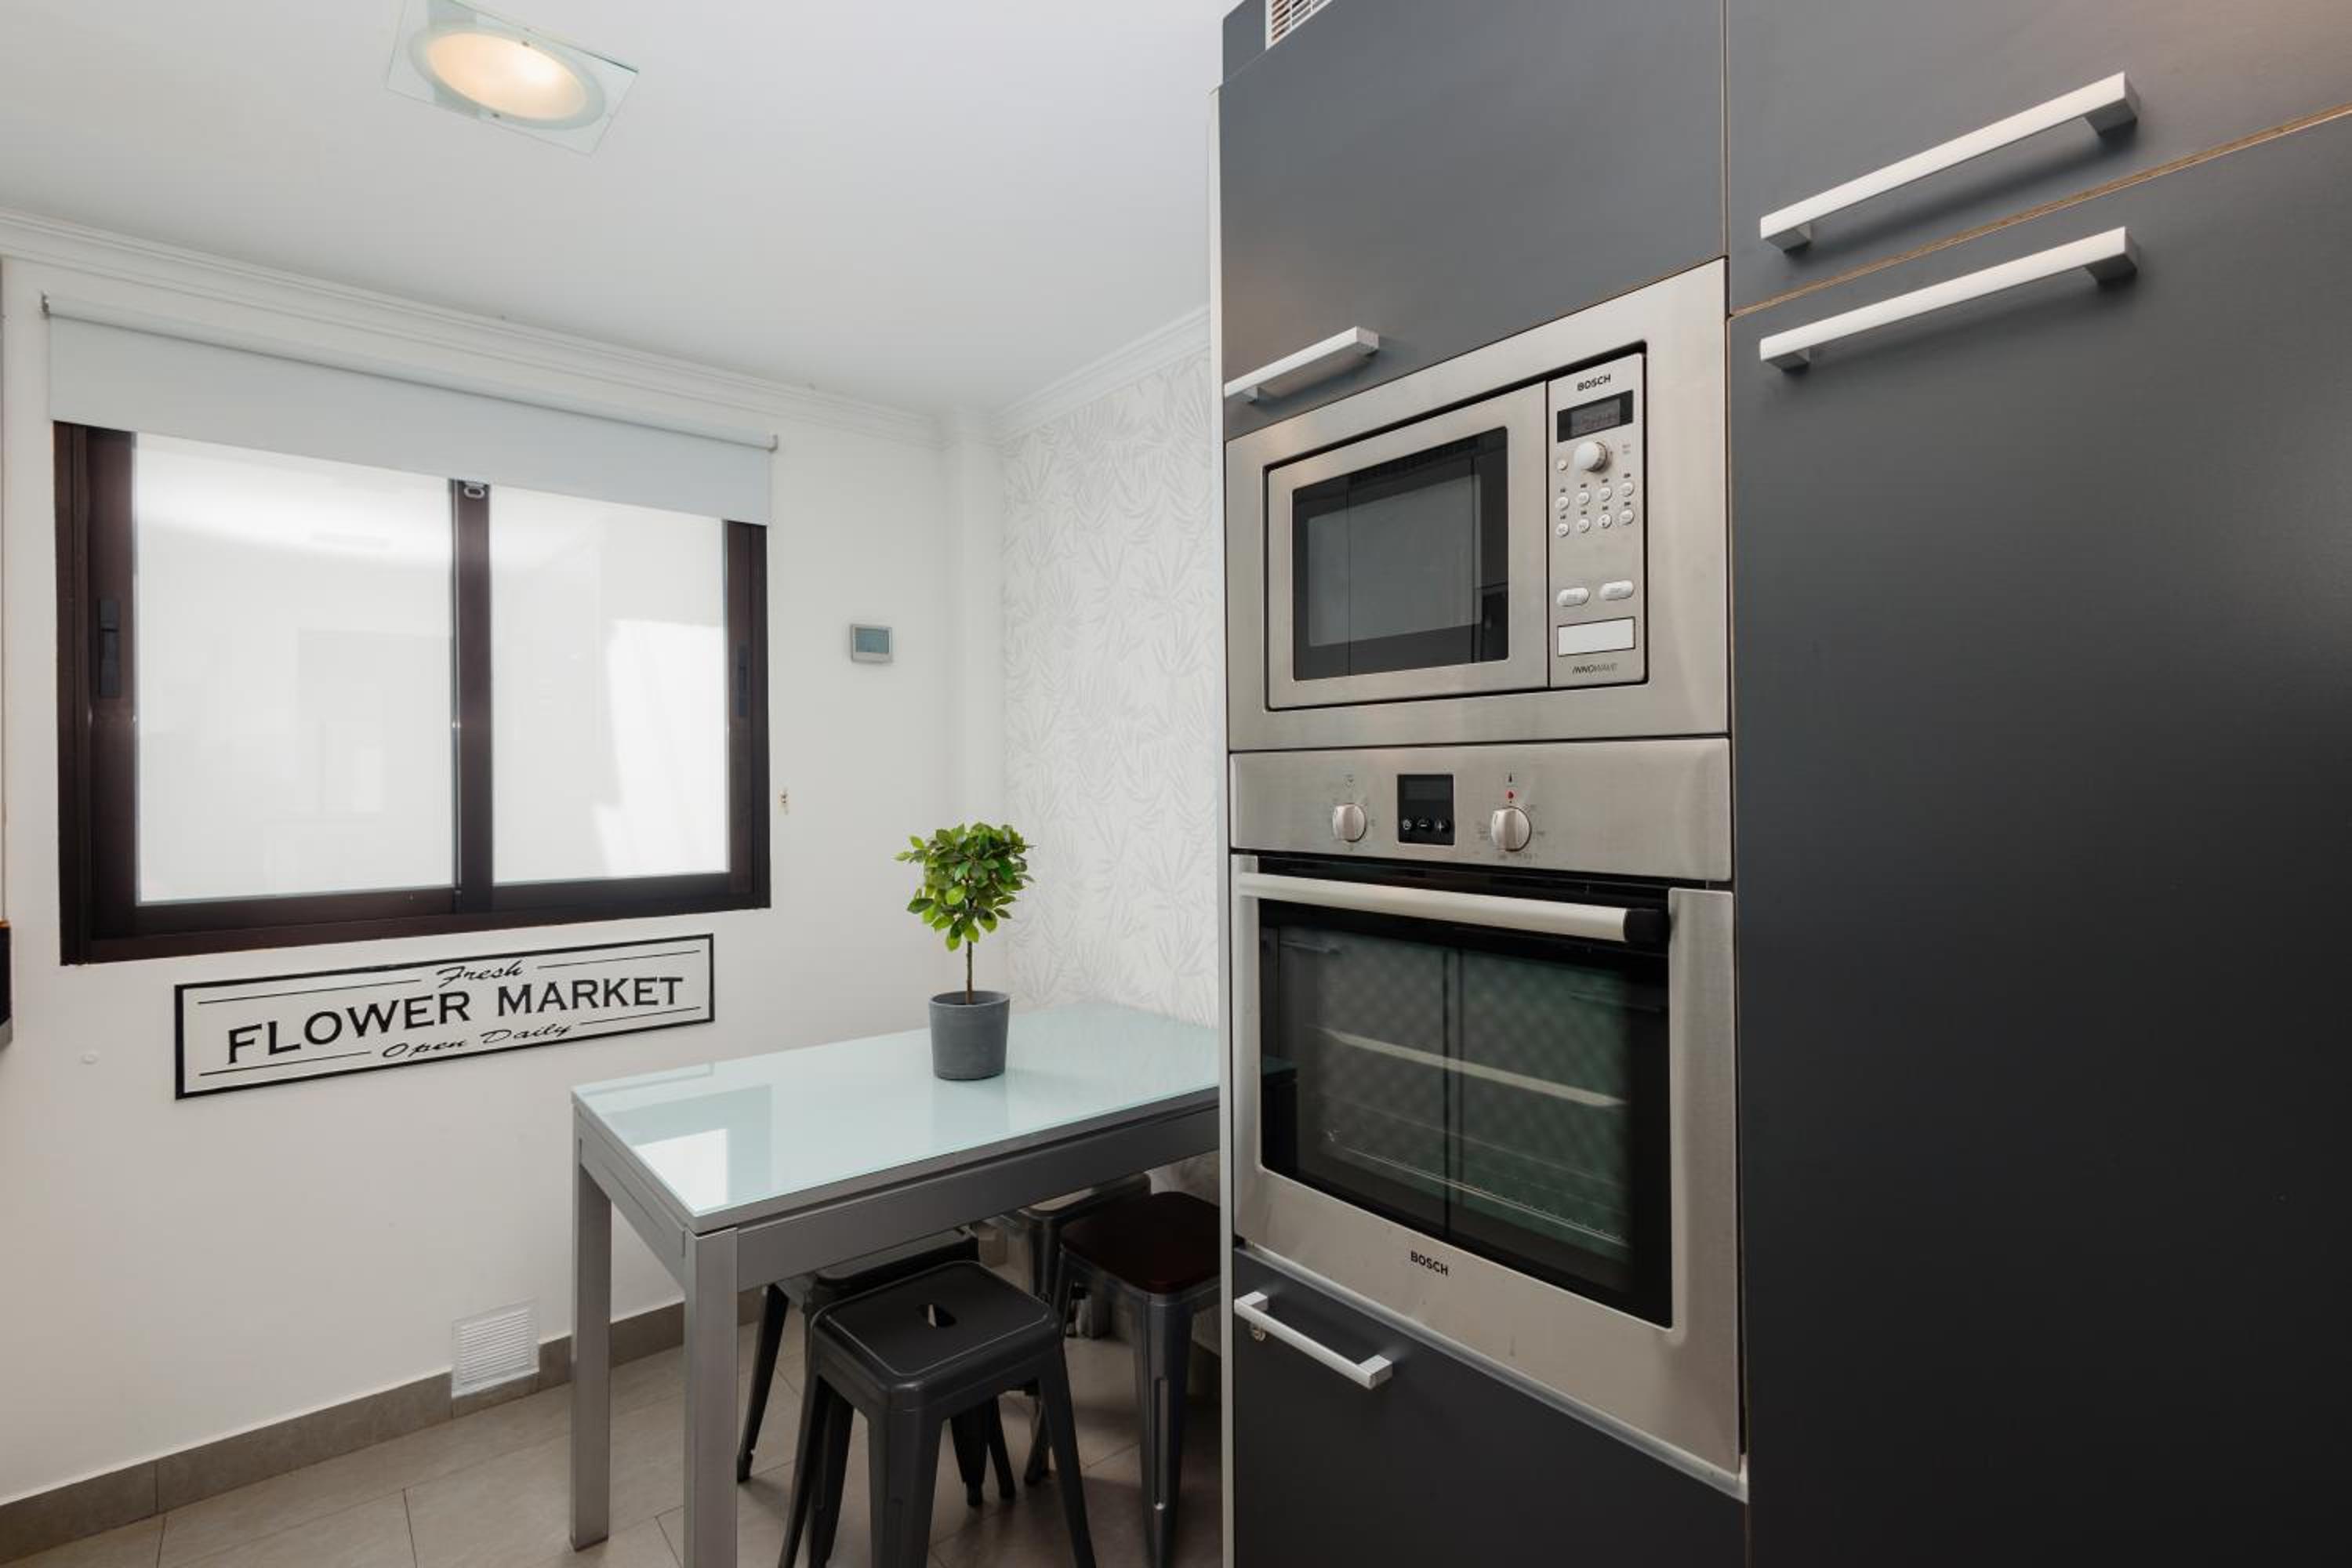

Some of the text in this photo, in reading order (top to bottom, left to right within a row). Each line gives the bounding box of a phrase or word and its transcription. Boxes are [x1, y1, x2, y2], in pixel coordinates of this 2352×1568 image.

[1577, 374, 1611, 391] BOSCH
[436, 960, 524, 989] Fresh
[227, 977, 684, 1065] FLOWER MARKET
[381, 1023, 572, 1058] Open Daily
[1410, 1250, 1449, 1276] BOSCH
